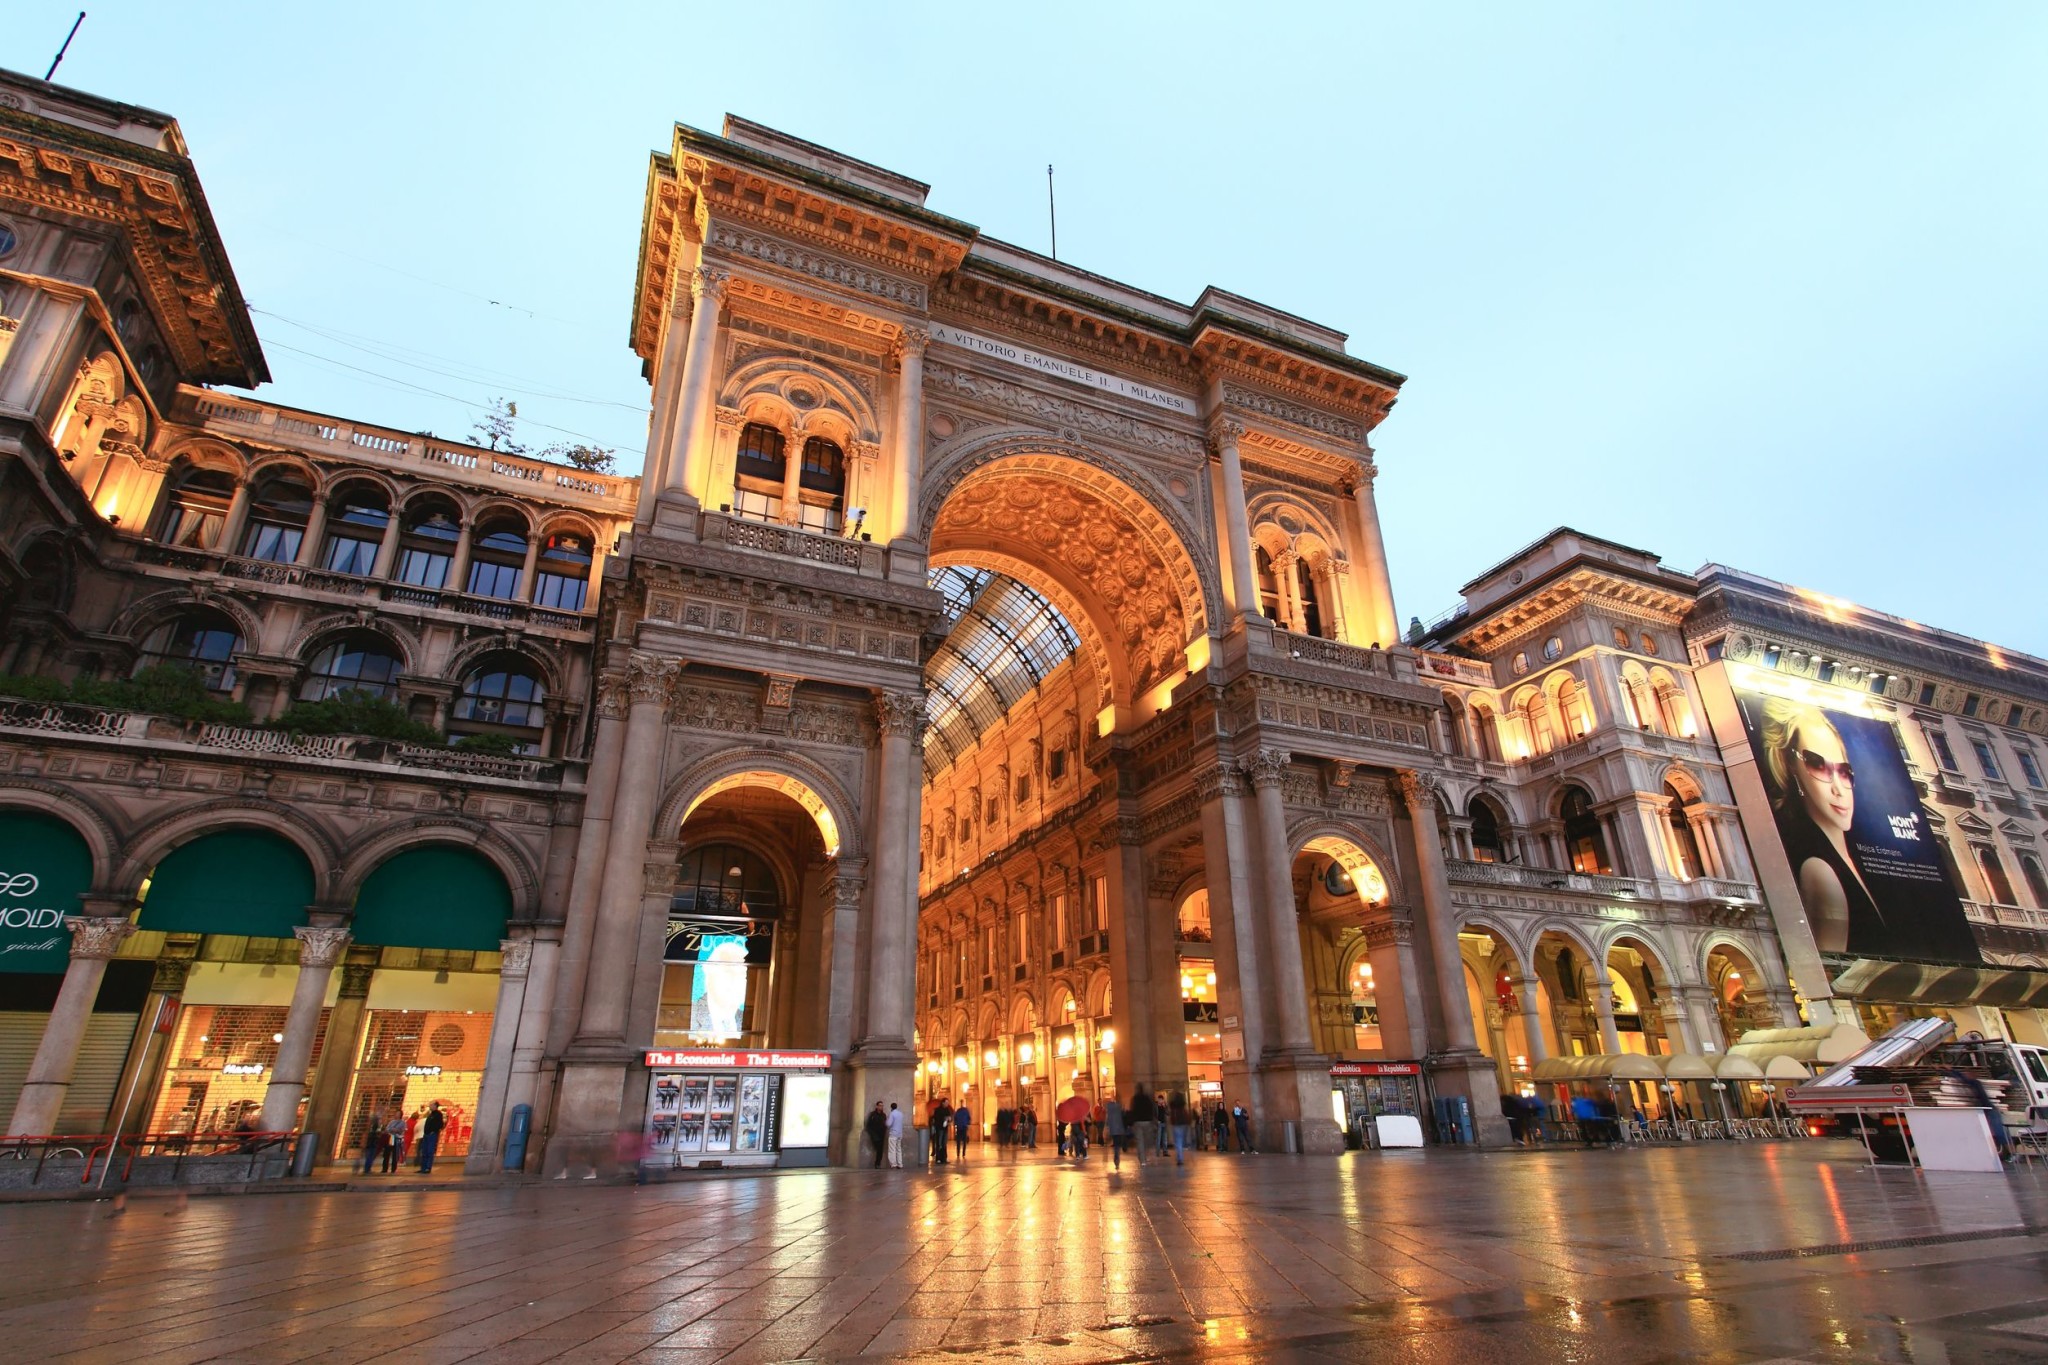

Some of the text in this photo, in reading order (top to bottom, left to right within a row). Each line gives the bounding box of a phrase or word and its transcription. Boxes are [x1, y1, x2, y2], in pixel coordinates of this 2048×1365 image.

[937, 328, 946, 338] A
[955, 333, 1016, 359] VITTORIO
[1024, 353, 1093, 382] EMANUELE
[1131, 385, 1185, 409] MILANESI
[1887, 814, 1915, 829] MONT
[1892, 826, 1921, 841] BLANC
[650, 1053, 735, 1065] The Economist
[747, 1053, 828, 1066] The Economist
[1384, 1065, 1411, 1073] Repubblica
